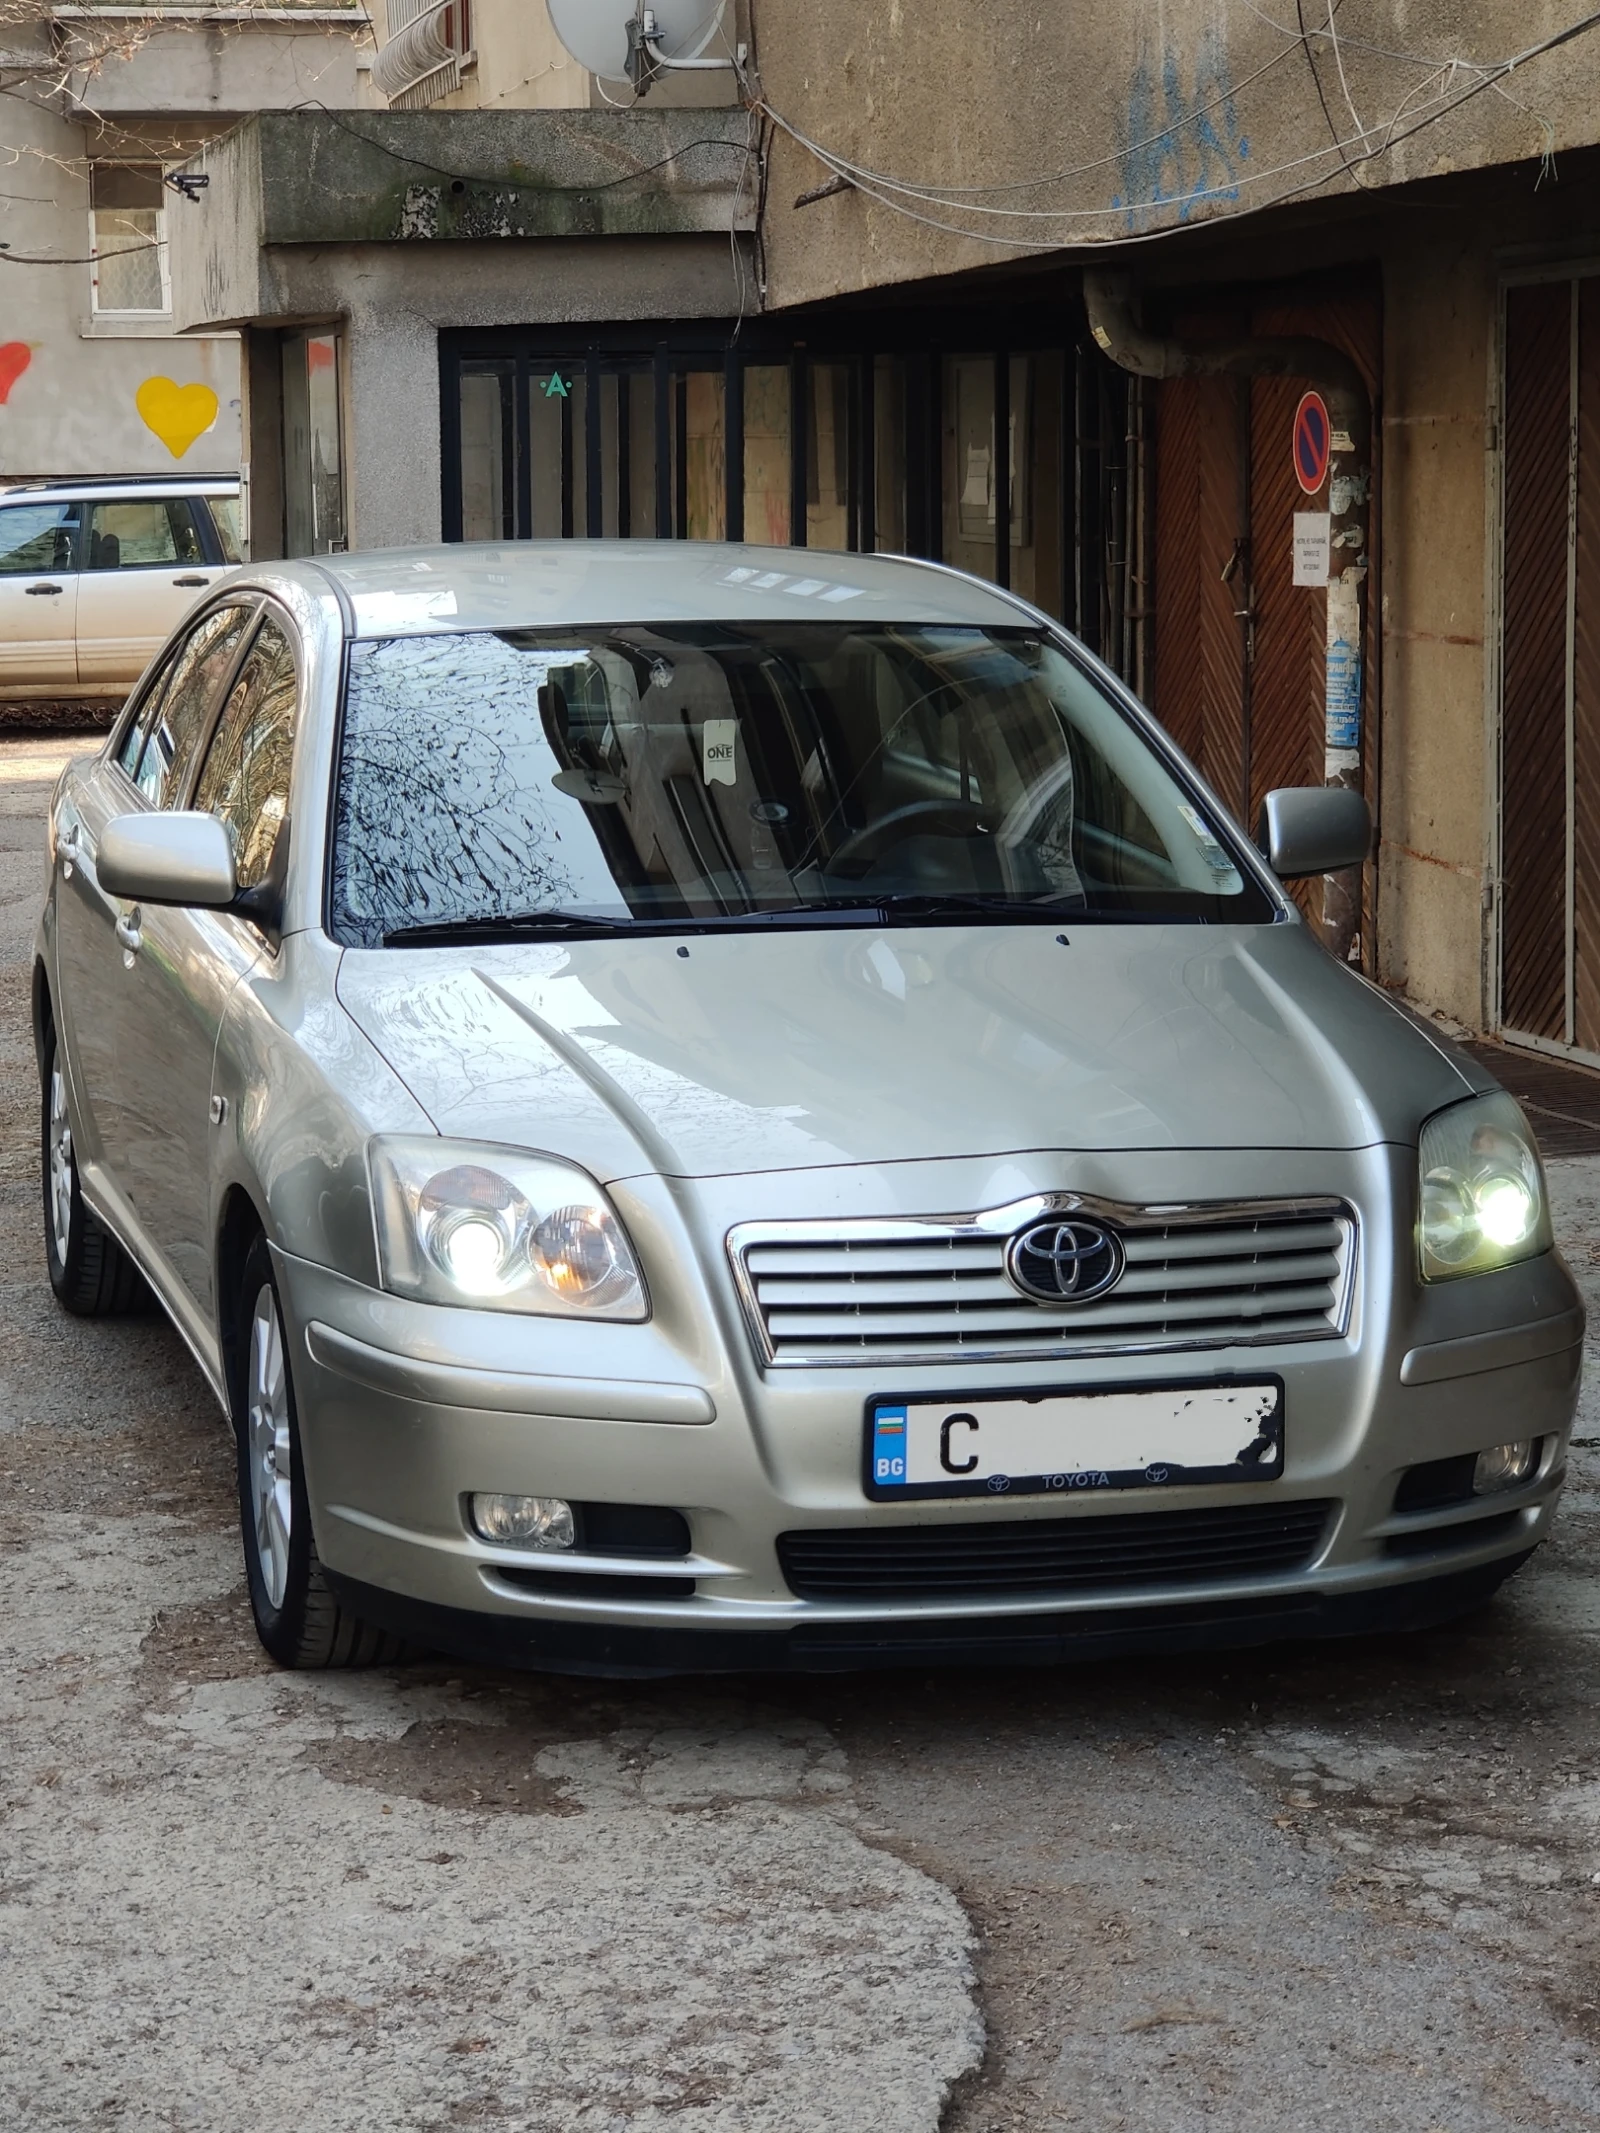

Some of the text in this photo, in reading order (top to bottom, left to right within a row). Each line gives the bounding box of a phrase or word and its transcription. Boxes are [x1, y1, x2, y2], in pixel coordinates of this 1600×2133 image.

[707, 746, 732, 759] ONE
[940, 1412, 979, 1474] C
[876, 1457, 904, 1477] BG
[1042, 1472, 1109, 1489] TOYOTA
